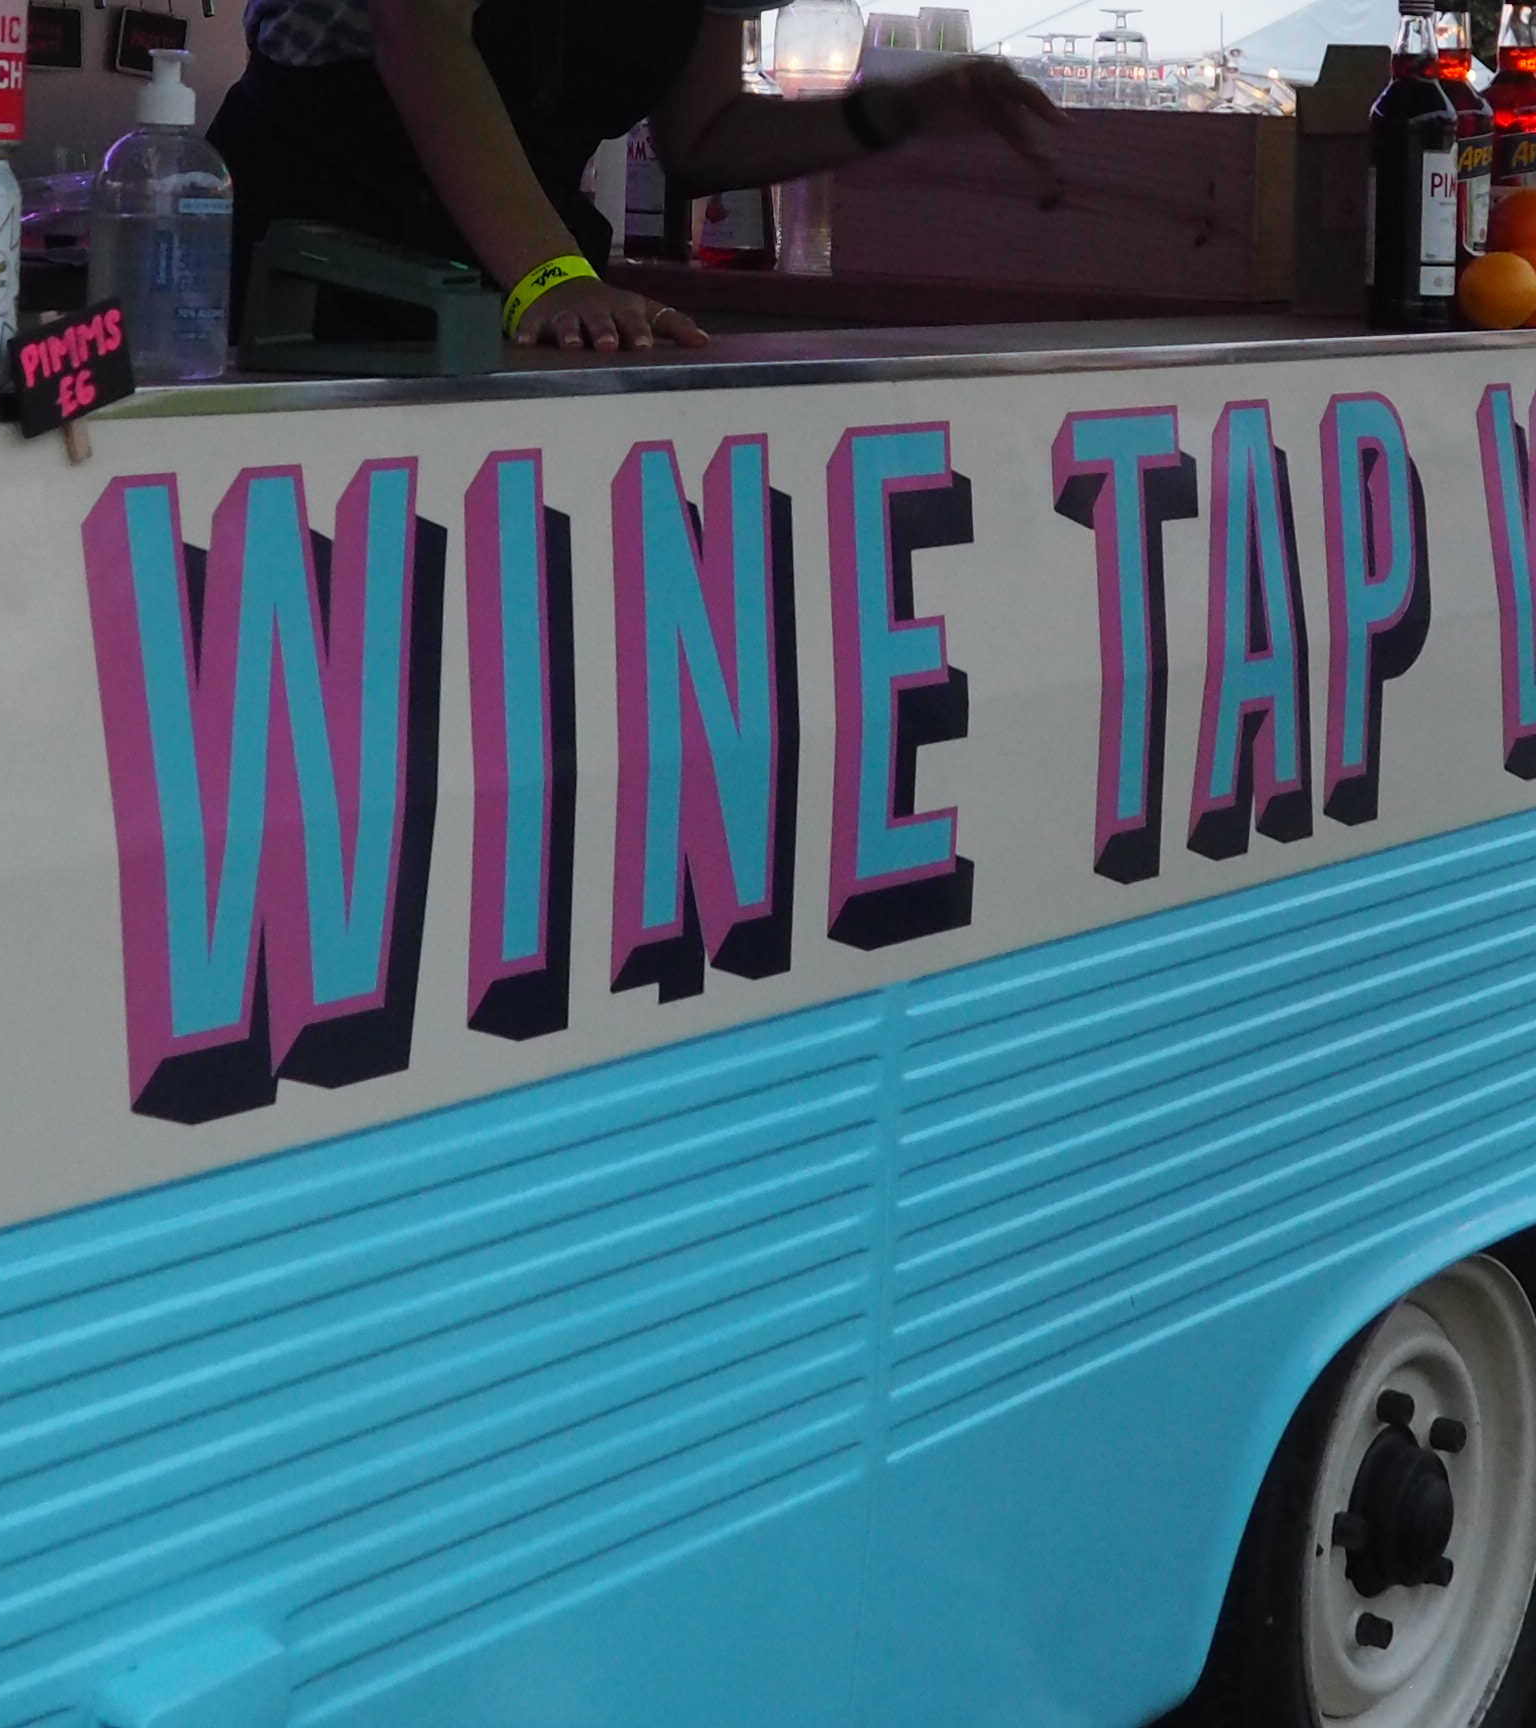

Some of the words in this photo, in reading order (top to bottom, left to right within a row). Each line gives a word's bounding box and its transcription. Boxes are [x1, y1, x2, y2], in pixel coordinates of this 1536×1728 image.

[19, 307, 123, 389] PIMMS
[80, 419, 974, 1128] WINE
[1050, 390, 1432, 886] TAP
